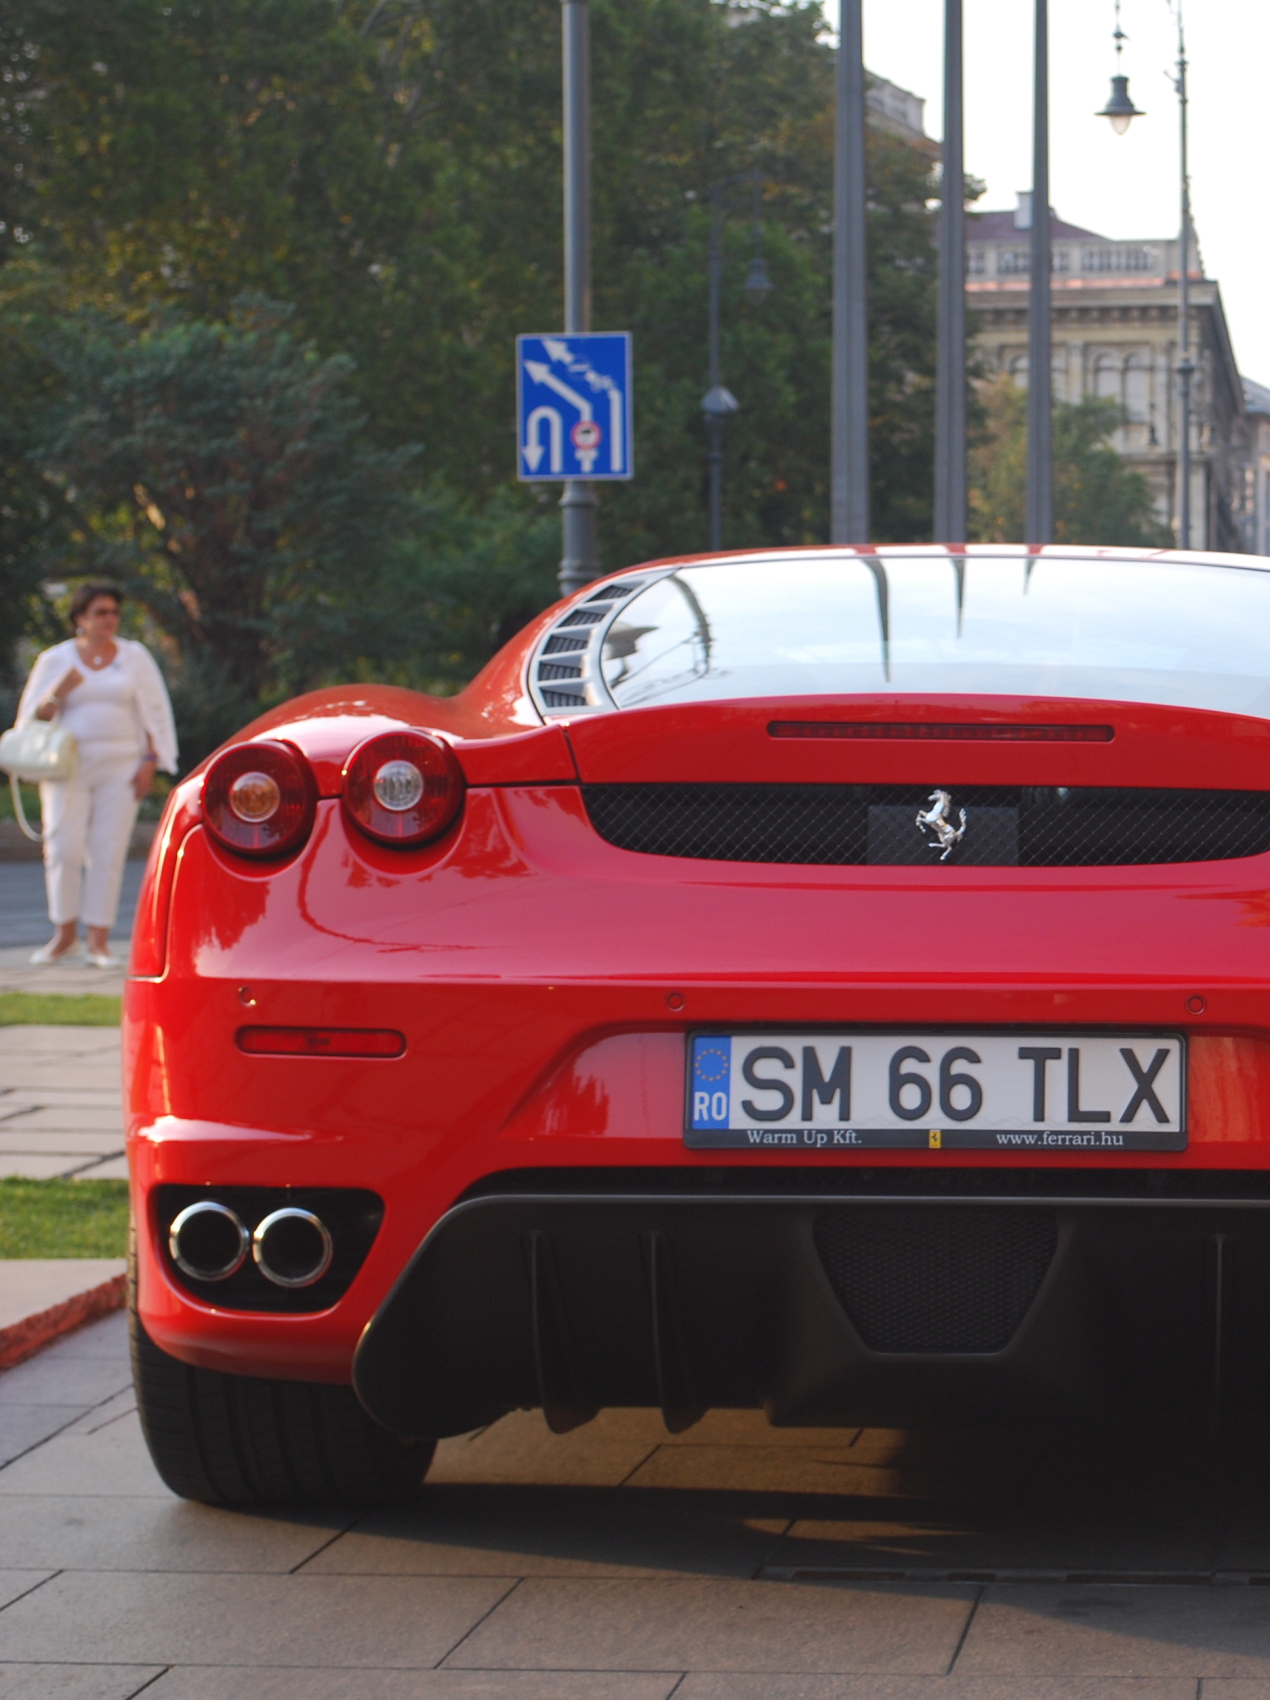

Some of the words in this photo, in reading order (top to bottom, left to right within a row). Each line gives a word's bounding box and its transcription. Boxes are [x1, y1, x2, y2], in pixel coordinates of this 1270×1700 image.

[741, 1046, 852, 1121] SM
[889, 1046, 983, 1121] 66
[1018, 1047, 1170, 1123] TLX
[693, 1091, 727, 1121] RO
[747, 1130, 797, 1144] Warm
[803, 1130, 827, 1147] Up
[833, 1130, 863, 1144] Kft.
[996, 1131, 1123, 1146] www.ferrari.hu
